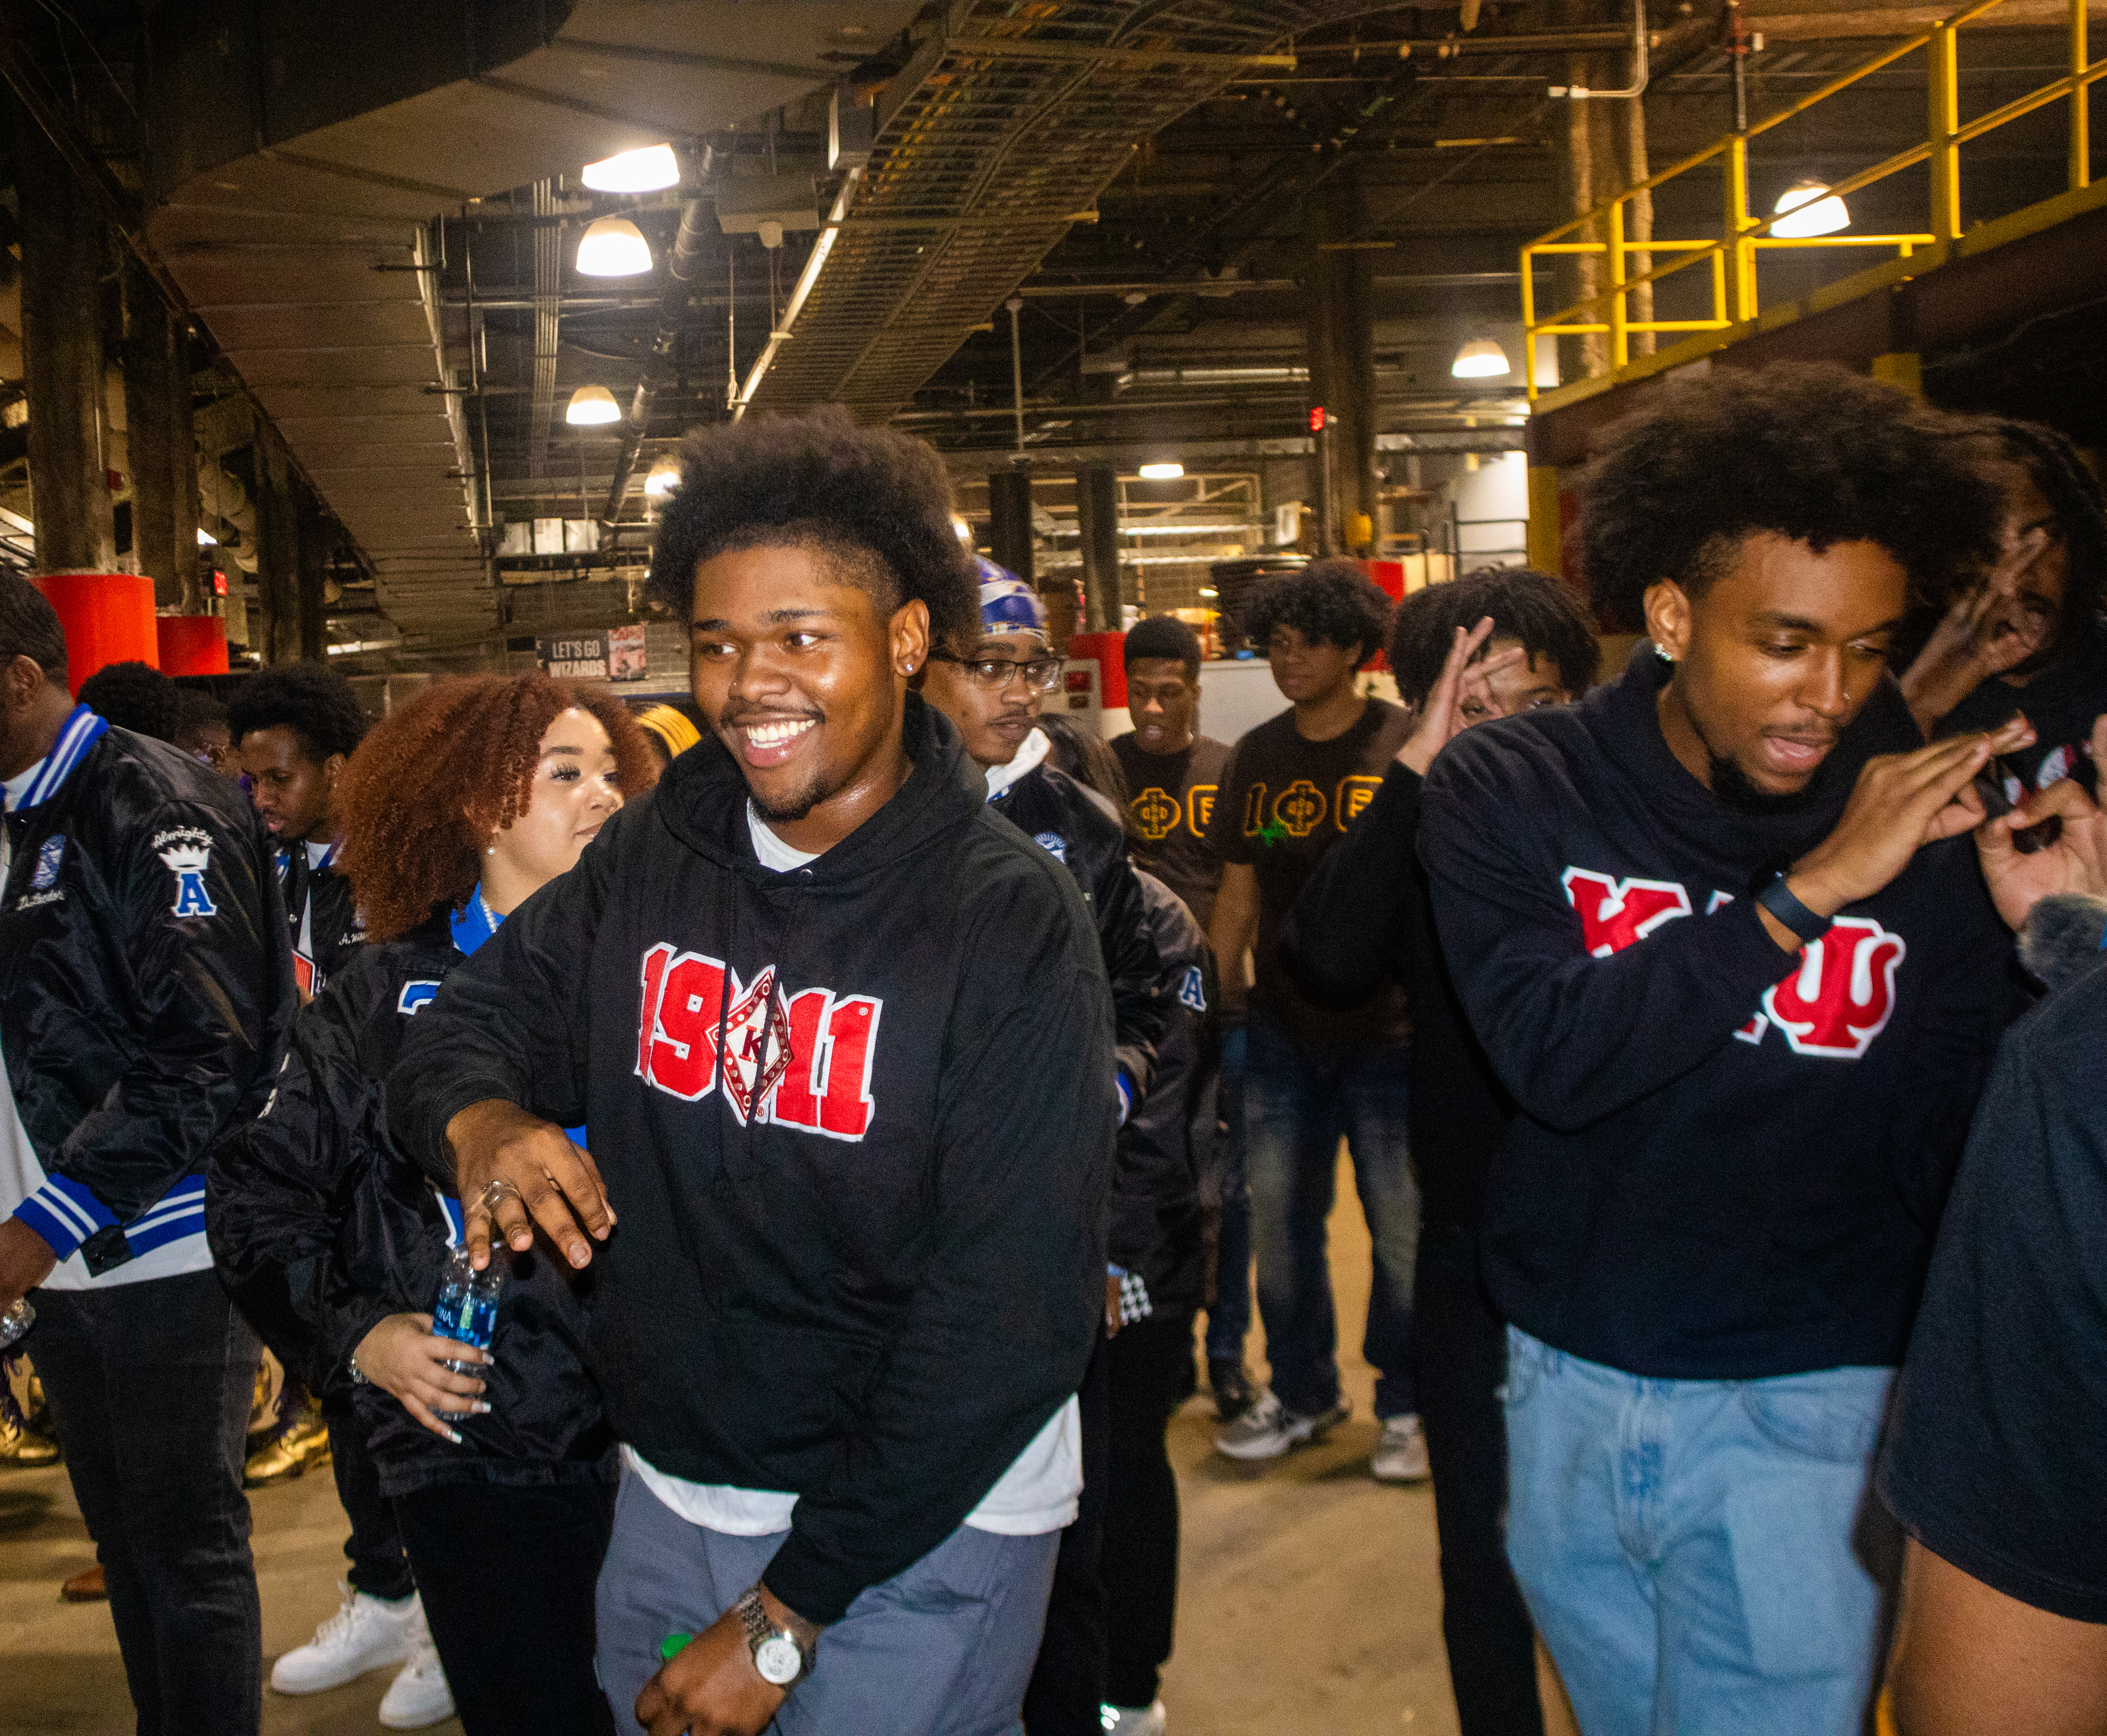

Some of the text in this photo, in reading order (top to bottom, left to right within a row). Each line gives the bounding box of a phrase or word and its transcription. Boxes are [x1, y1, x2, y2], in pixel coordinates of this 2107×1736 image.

[553, 640, 600, 658] LET'S GO
[548, 660, 606, 677] WIZARDS
[151, 825, 214, 849] Almighty
[170, 871, 217, 917] A
[1178, 966, 1207, 1012] A
